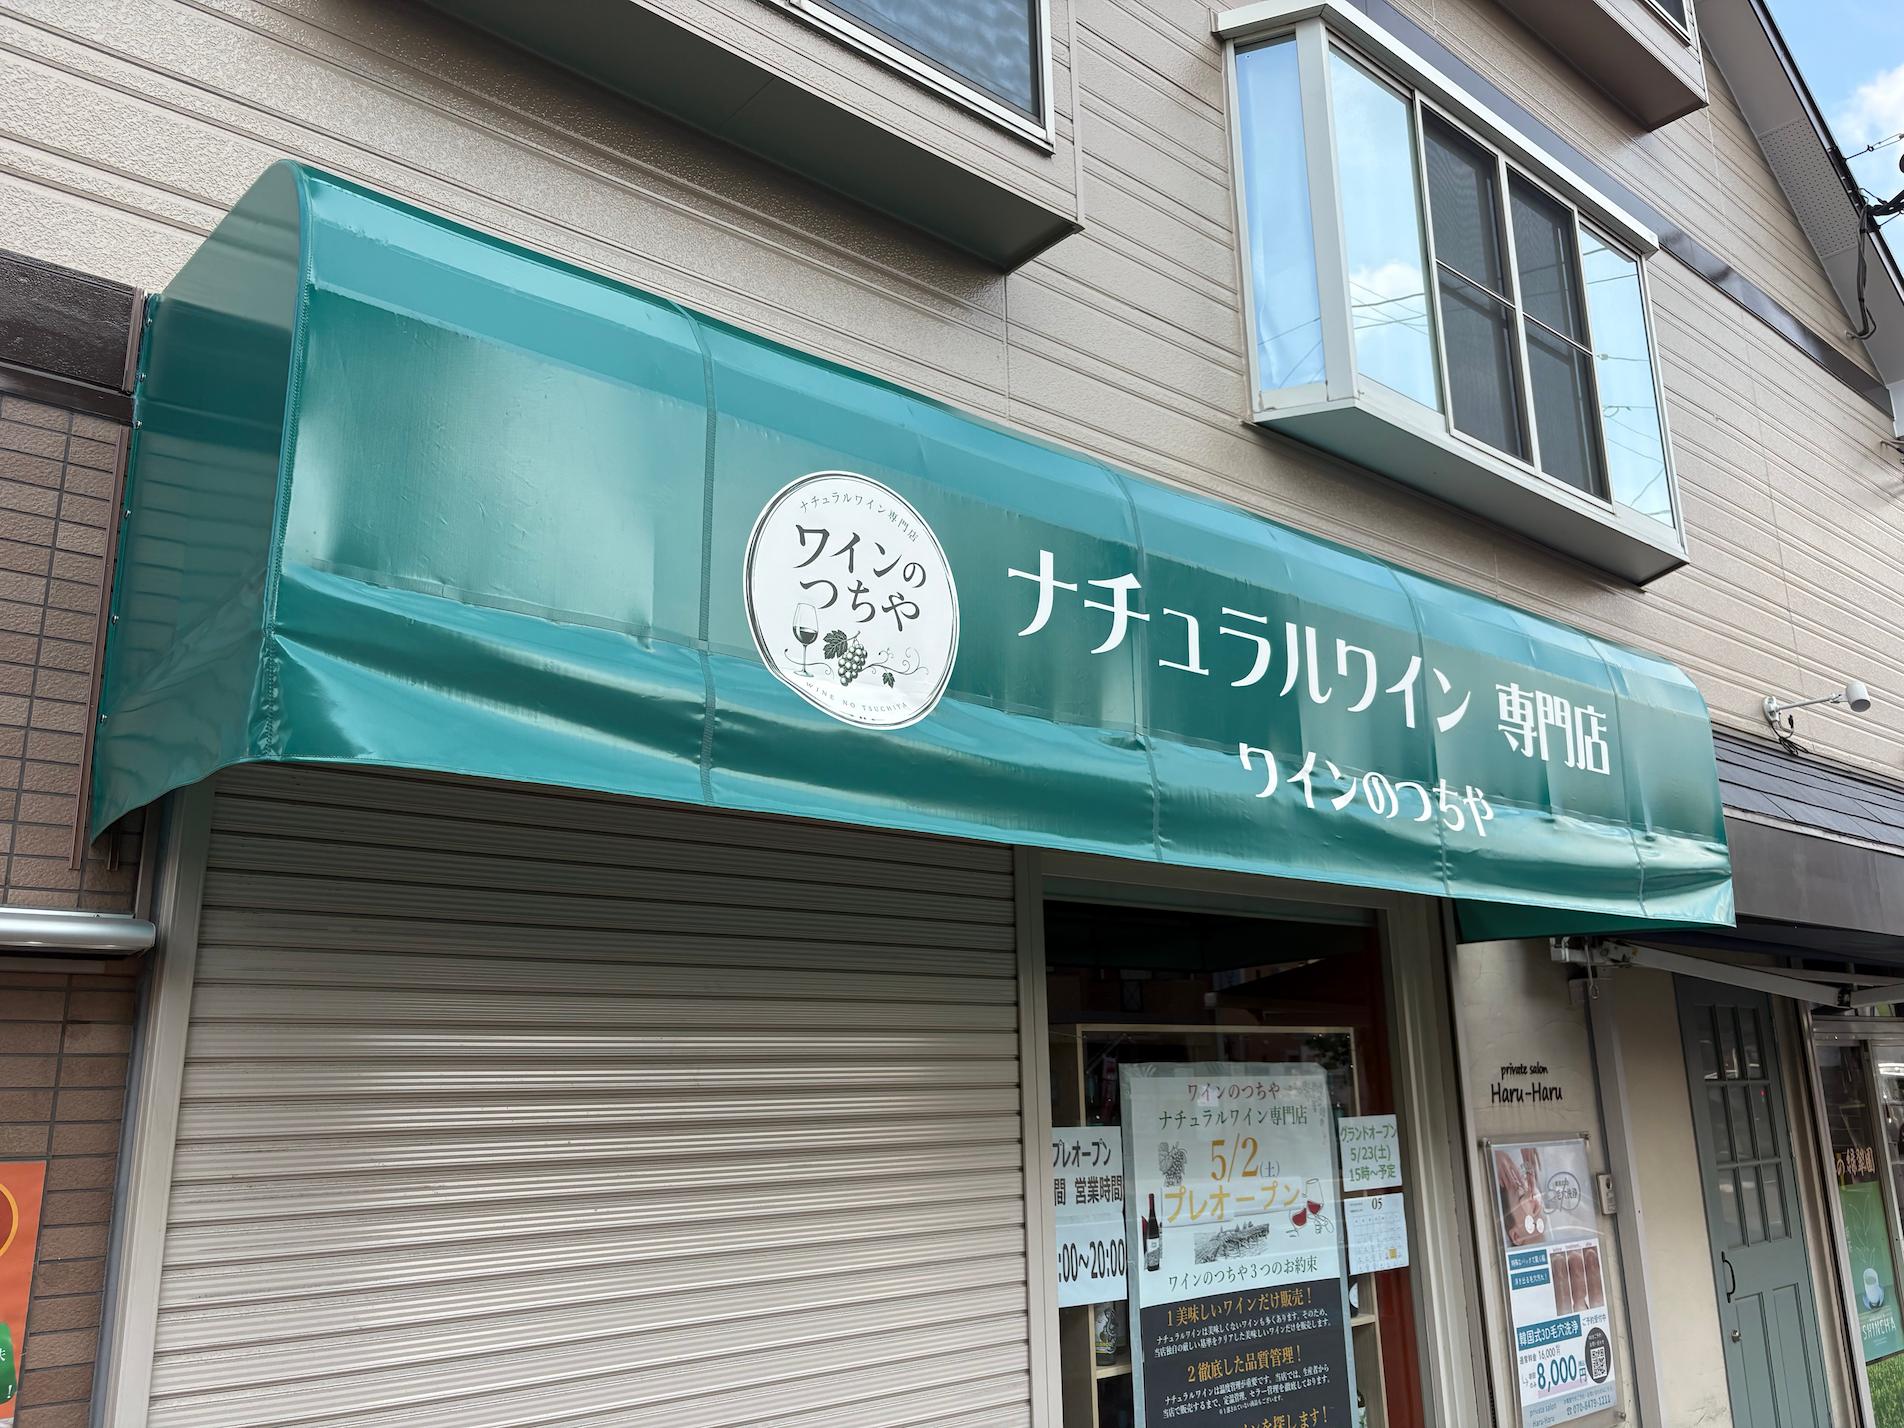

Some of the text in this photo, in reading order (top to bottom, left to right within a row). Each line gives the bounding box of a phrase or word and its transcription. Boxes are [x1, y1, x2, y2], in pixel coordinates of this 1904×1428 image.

[799, 491, 920, 543] ナチュラルワイン専門店
[793, 524, 927, 589] ワインの
[799, 579, 921, 632] つちや
[1007, 549, 1611, 776] ナチュラルワイン 専門店
[806, 681, 908, 712] WINE NO TSUCHIYA
[1238, 741, 1495, 838] ワインのつちや
[1501, 1061, 1549, 1081] private salon
[1187, 1081, 1281, 1102] ワインのつちや
[1490, 1081, 1563, 1104] Haru-Haru
[1159, 1105, 1308, 1130] ナチュラルワイン専門店
[1340, 1122, 1397, 1143] グランドオープン
[1074, 1175, 1123, 1205] 営業時間
[1164, 1180, 1300, 1223] プレオープン
[1168, 1255, 1318, 1292] ワインのつちや3つのお約束
